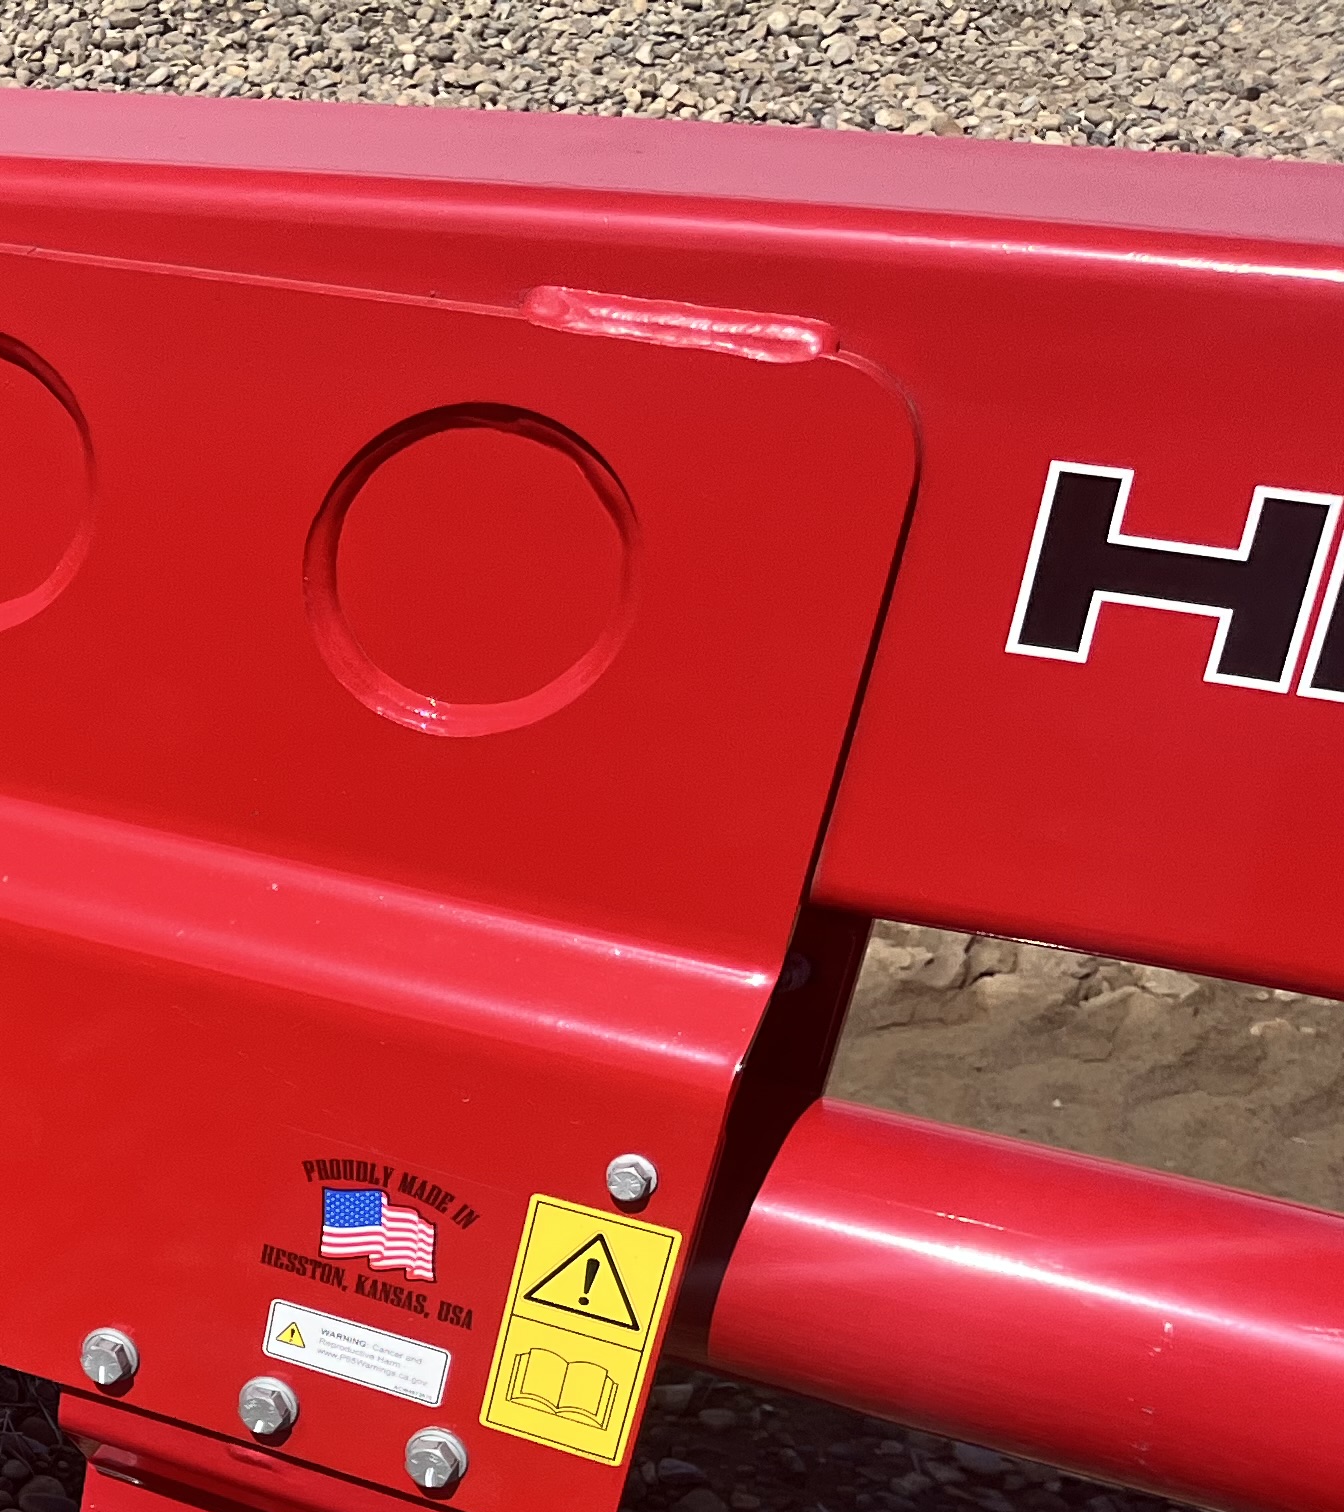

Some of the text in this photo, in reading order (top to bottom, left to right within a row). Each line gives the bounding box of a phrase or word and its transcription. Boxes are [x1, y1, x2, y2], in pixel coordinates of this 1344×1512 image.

[1005, 460, 1344, 703] H
[302, 1159, 480, 1230] PROUDLY MADE IN
[260, 1244, 474, 1330] HESSTON, KANSAS, USA
[318, 1337, 402, 1368] Reproductive Harm
[372, 1343, 403, 1359] Cancer
